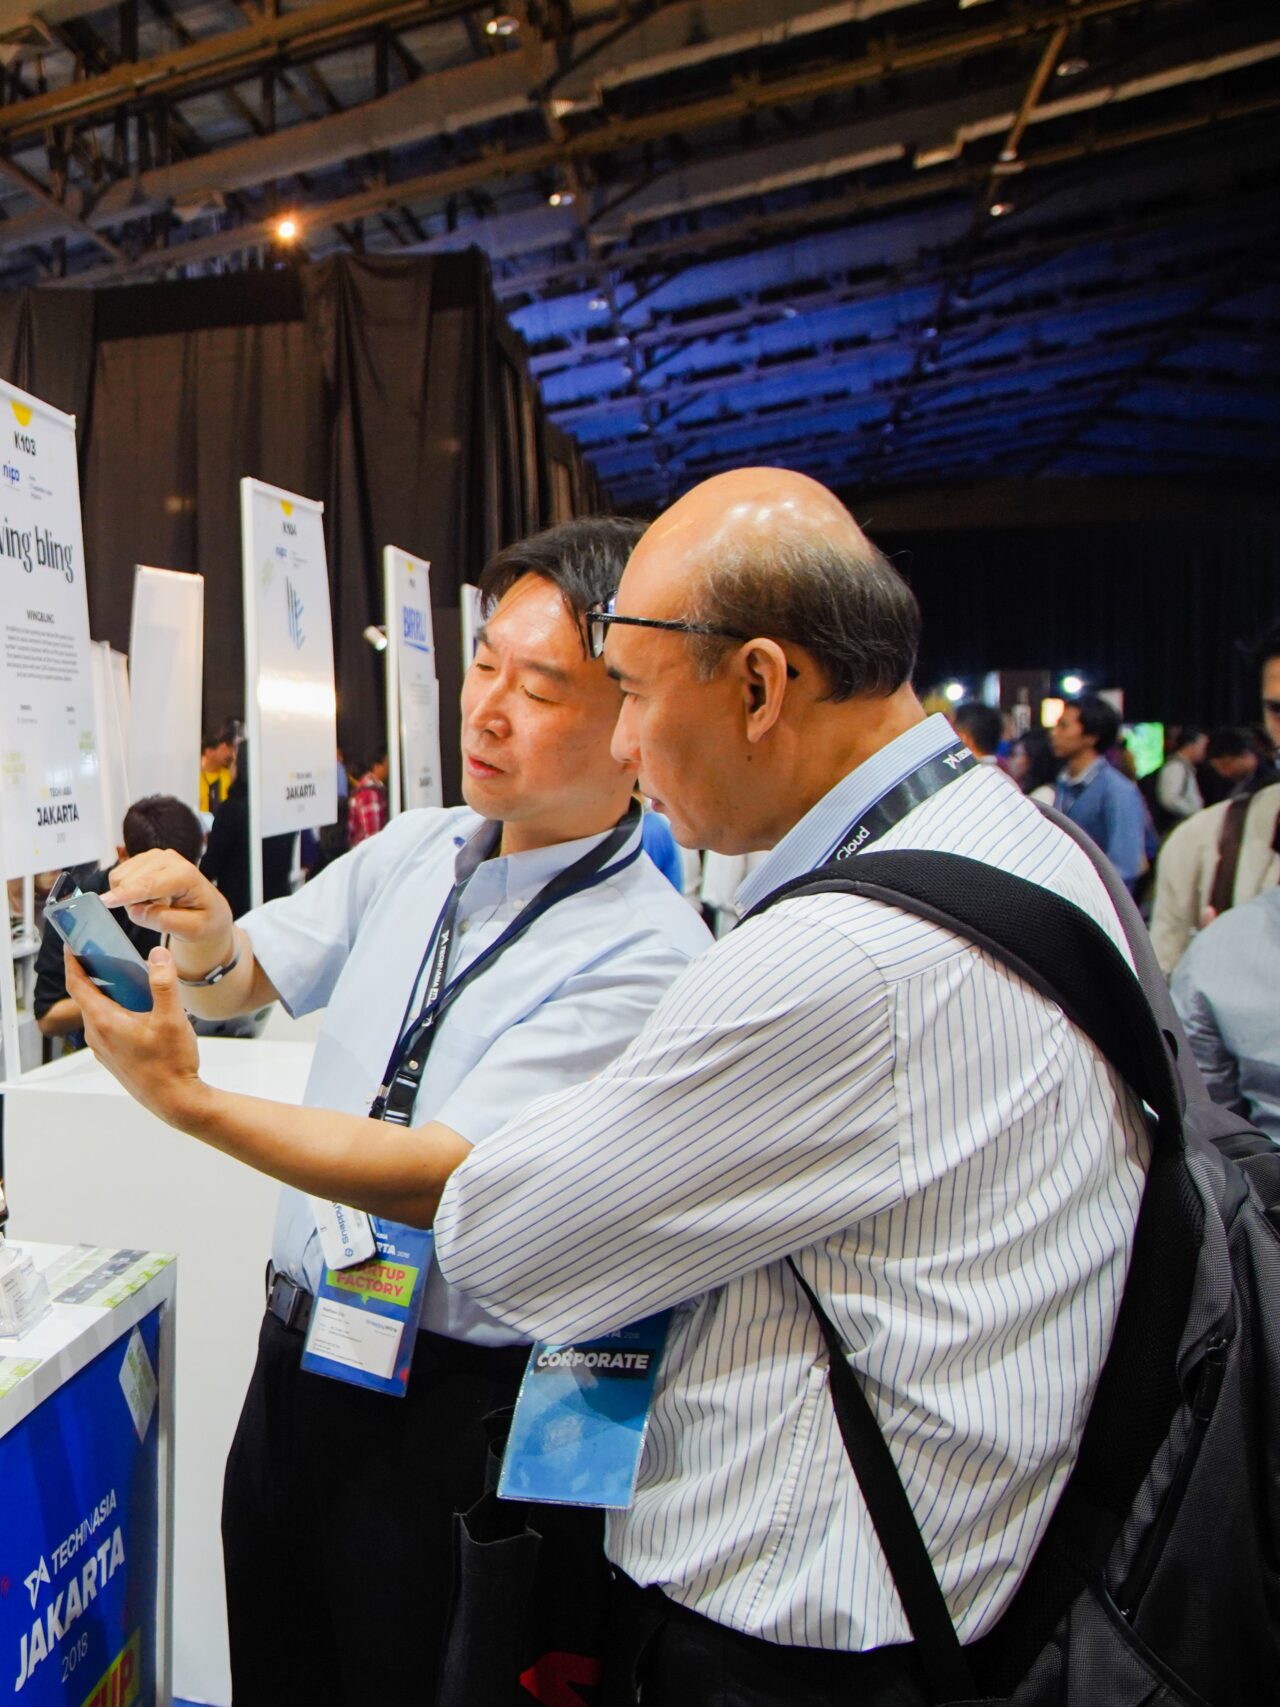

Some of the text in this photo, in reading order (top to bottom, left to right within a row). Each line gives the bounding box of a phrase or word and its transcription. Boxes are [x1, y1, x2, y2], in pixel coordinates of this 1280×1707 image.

[14, 431, 37, 456] K103
[2, 460, 20, 484] nipa
[286, 784, 316, 800] JAKARTA
[37, 803, 79, 826] JAKARTA
[837, 826, 870, 860] Cloud
[336, 1273, 403, 1297] FACTORY
[537, 1352, 649, 1369] CORPORATE
[15, 1526, 125, 1693] JAKARTA
[62, 1632, 88, 1683] 2018
